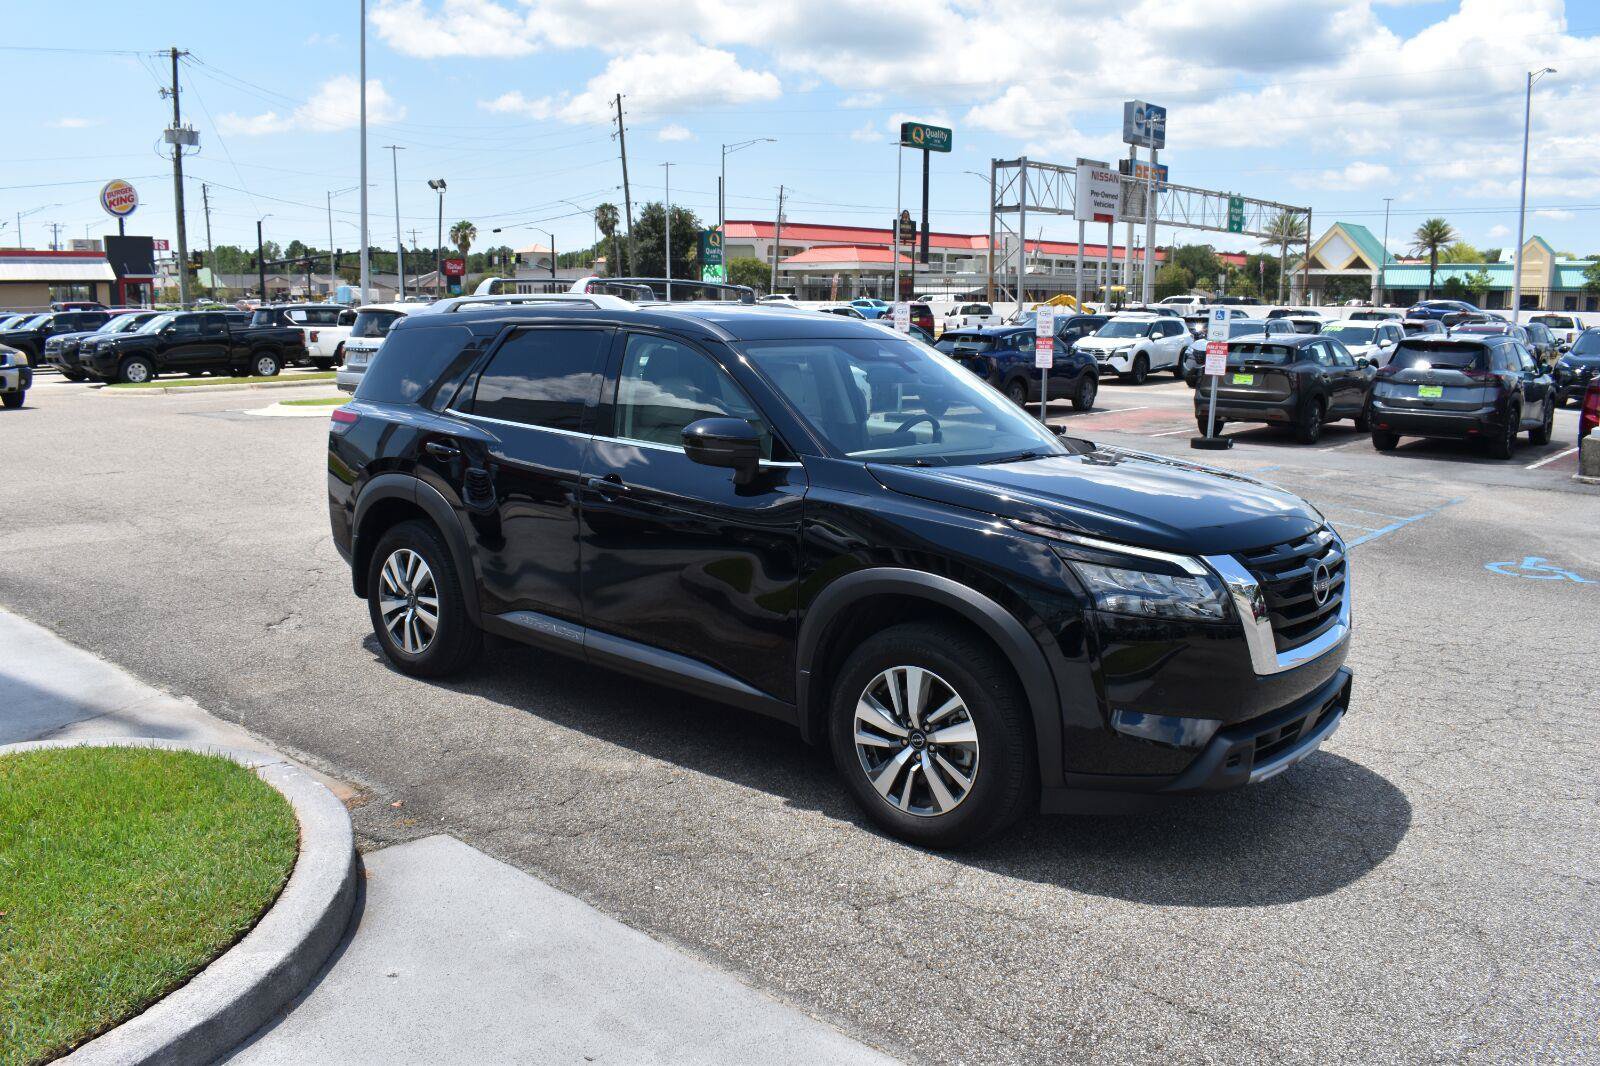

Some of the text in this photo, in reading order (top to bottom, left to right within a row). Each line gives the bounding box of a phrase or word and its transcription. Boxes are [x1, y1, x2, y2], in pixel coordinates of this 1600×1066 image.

[925, 128, 948, 142] Quality
[1091, 170, 1119, 184] NISSAN
[106, 187, 133, 200] BURGER
[1090, 190, 1119, 200] Pre-Owned
[109, 195, 135, 209] KING
[1094, 200, 1115, 209] Vehicles
